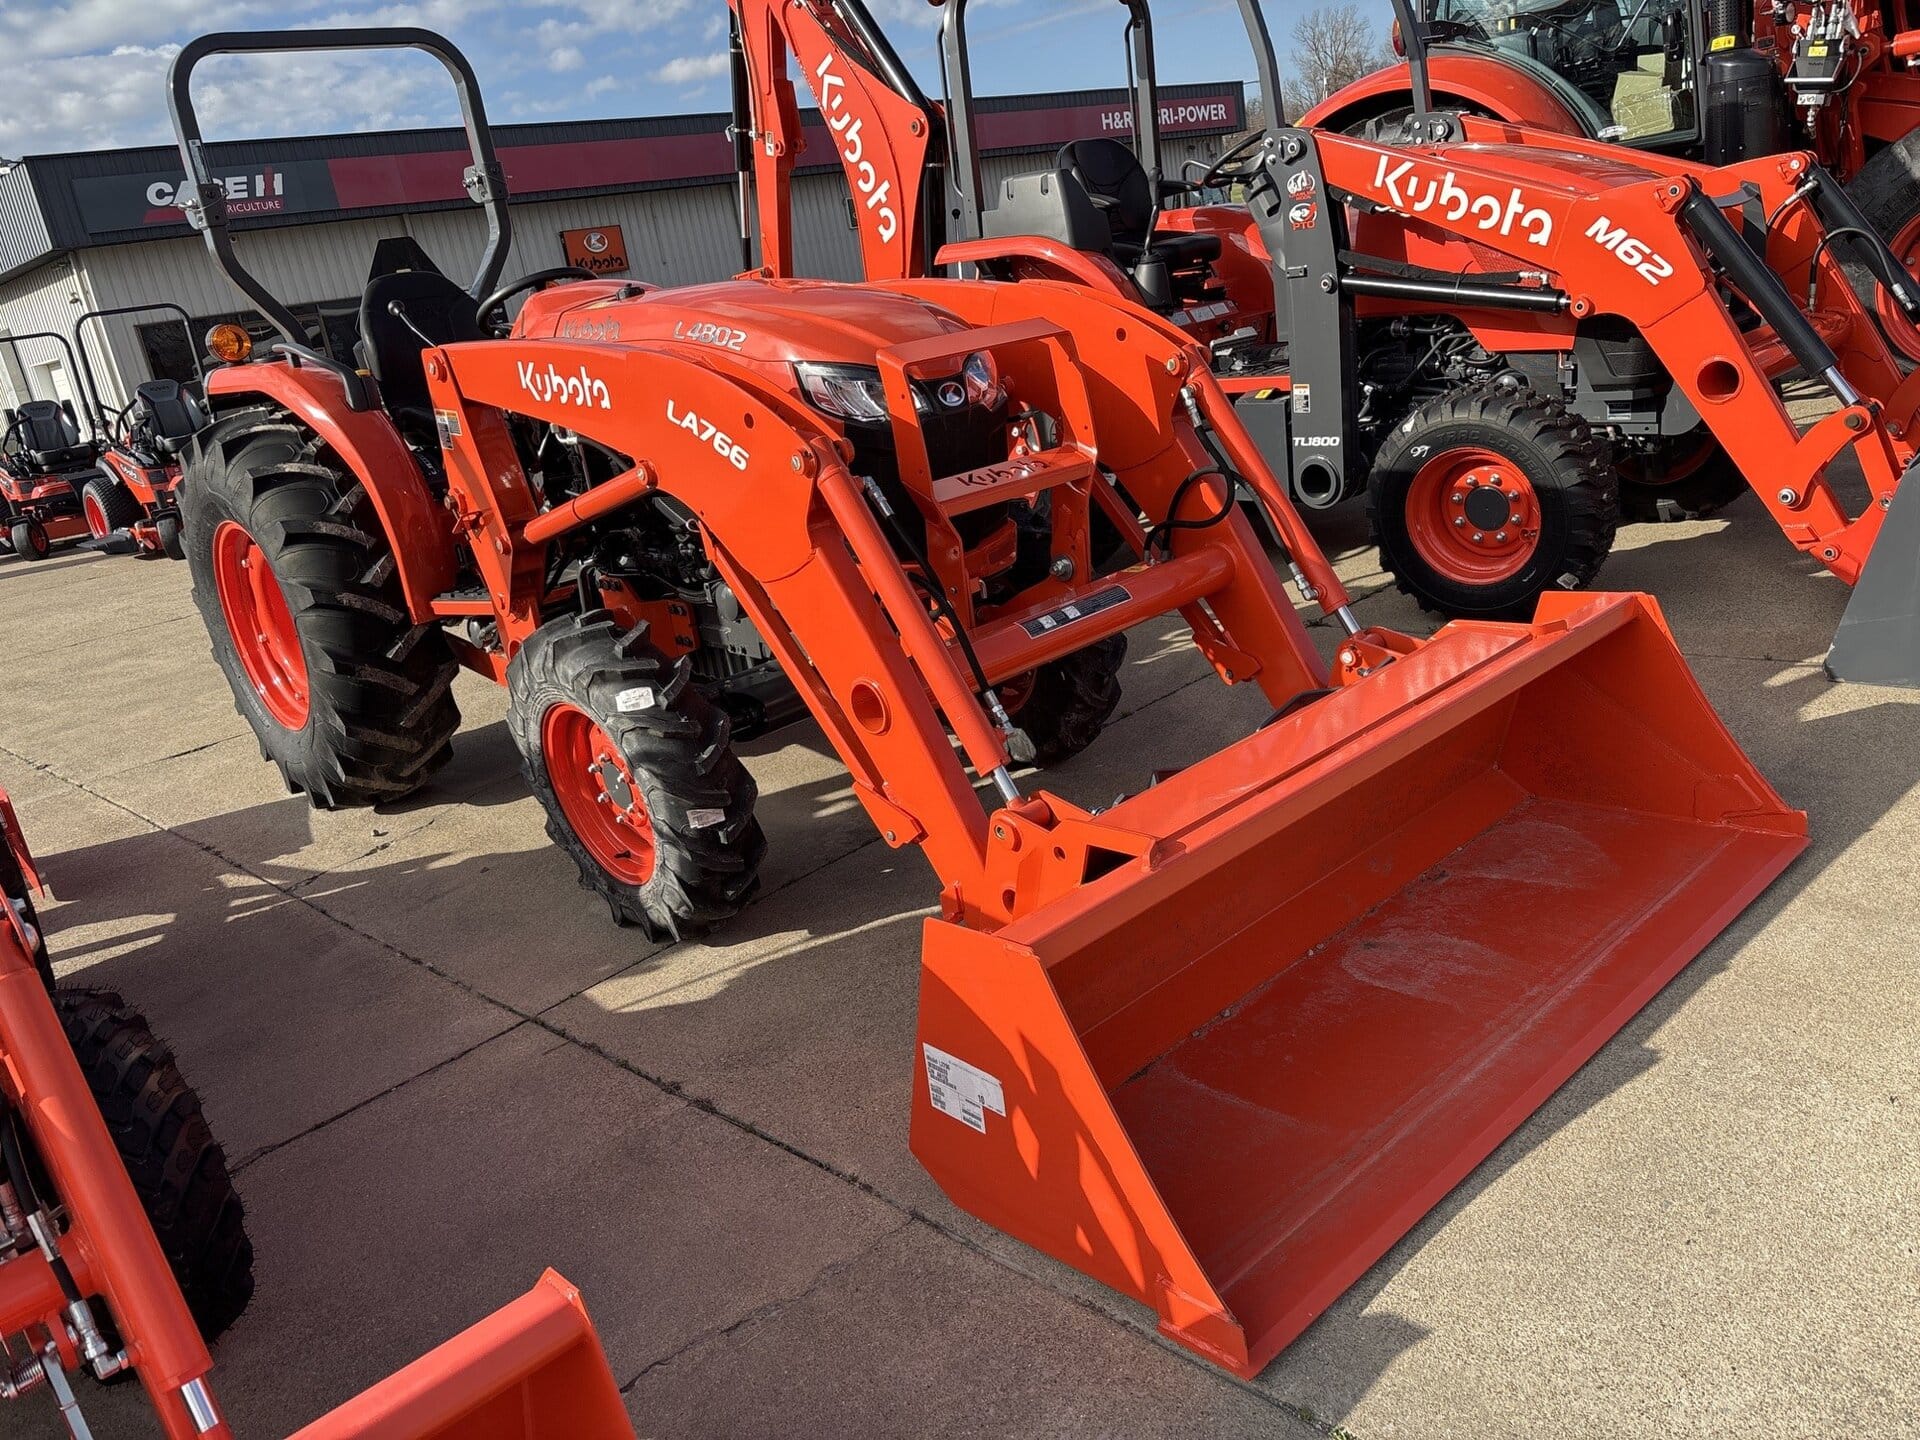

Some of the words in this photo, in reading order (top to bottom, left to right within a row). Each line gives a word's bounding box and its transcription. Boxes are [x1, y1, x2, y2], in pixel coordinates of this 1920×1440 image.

[1157, 104, 1227, 125] RI-POWER
[816, 53, 897, 244] Kubota
[226, 200, 281, 213] RICULTURE
[1374, 155, 1553, 247] Kubota
[1292, 221, 1315, 231] PTO
[574, 254, 625, 270] Kubota
[1584, 215, 1675, 287] M62
[562, 316, 621, 341] Kubota
[517, 361, 612, 410] Kubota
[666, 399, 750, 471] LA766
[1292, 436, 1341, 447] TL1800
[956, 460, 1050, 486] Kubota
